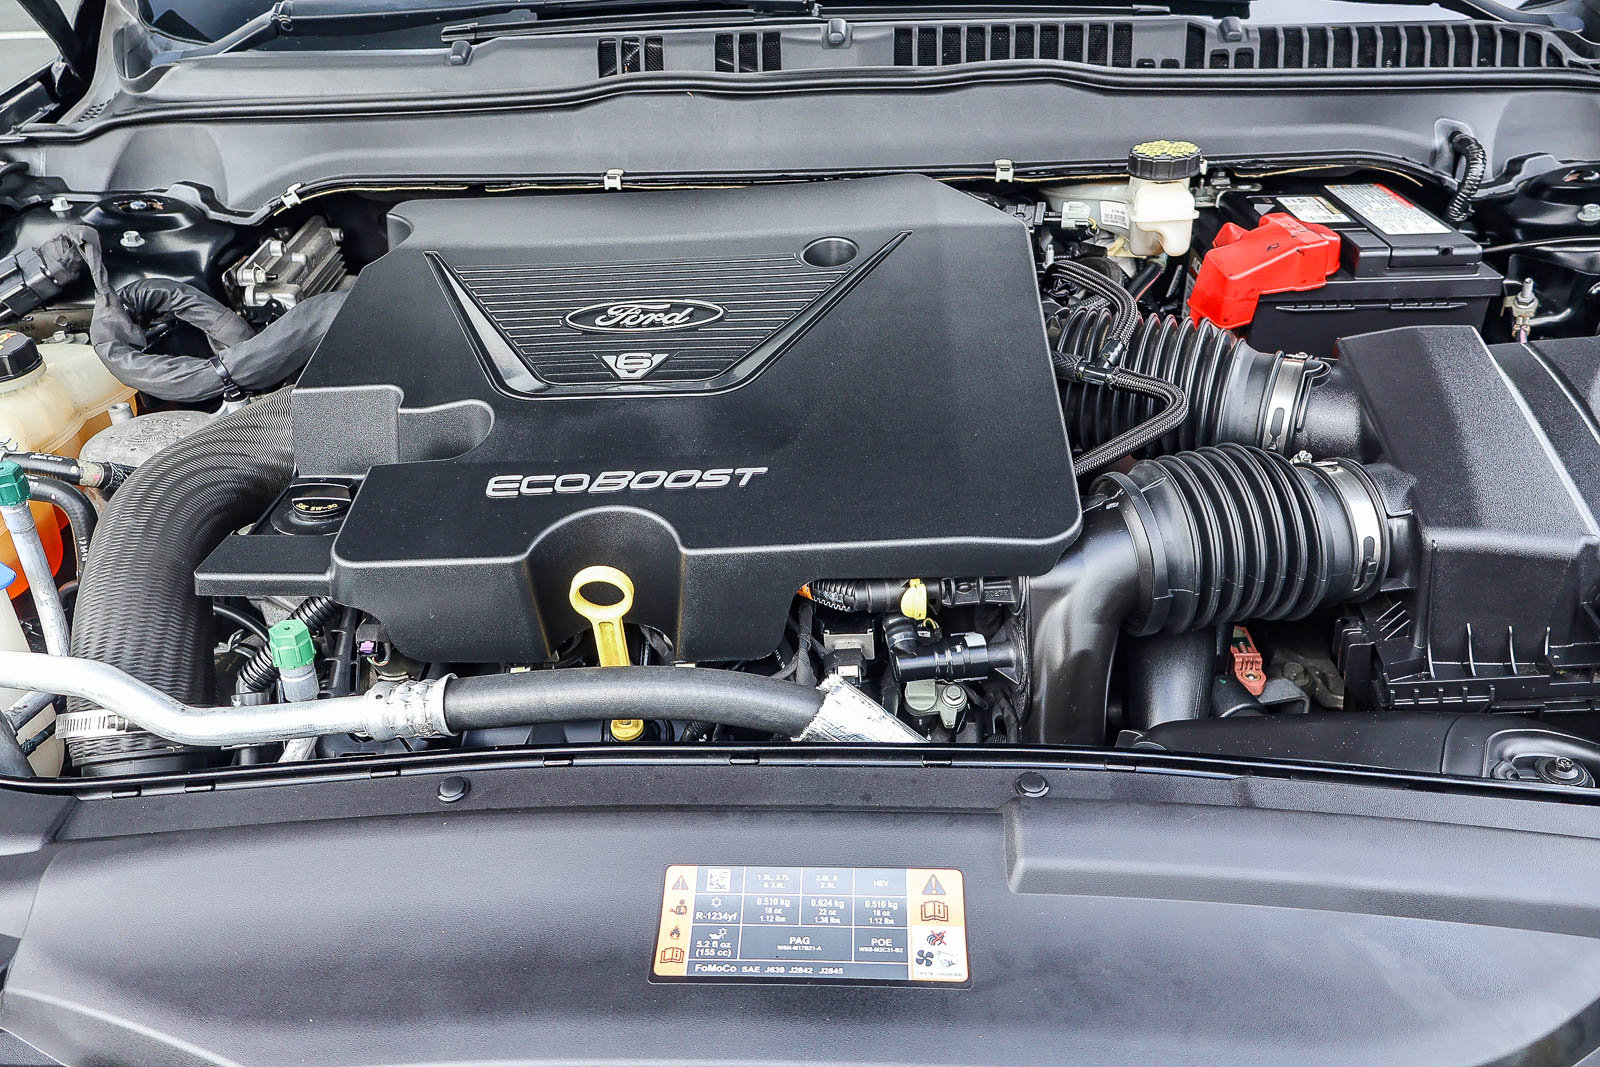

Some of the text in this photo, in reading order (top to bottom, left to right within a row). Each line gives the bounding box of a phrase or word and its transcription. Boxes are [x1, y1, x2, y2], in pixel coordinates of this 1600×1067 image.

[594, 303, 694, 327] Ford
[485, 466, 768, 498] ECOBOOST
[756, 897, 791, 908] 0.510 kg
[810, 898, 845, 909] 0.624 kg
[864, 900, 898, 910] 0.510 kg
[695, 911, 738, 922] R-1234yf
[829, 916, 841, 924] lbs
[868, 917, 895, 925] 1.12 lbs
[696, 940, 710, 948] 5.2
[711, 940, 718, 948] fl
[789, 936, 811, 945] PAG
[871, 938, 893, 947] POE
[695, 949, 732, 957] (155 cc)
[694, 963, 844, 975] FoMoCo SAE J639 J2842 J2845
